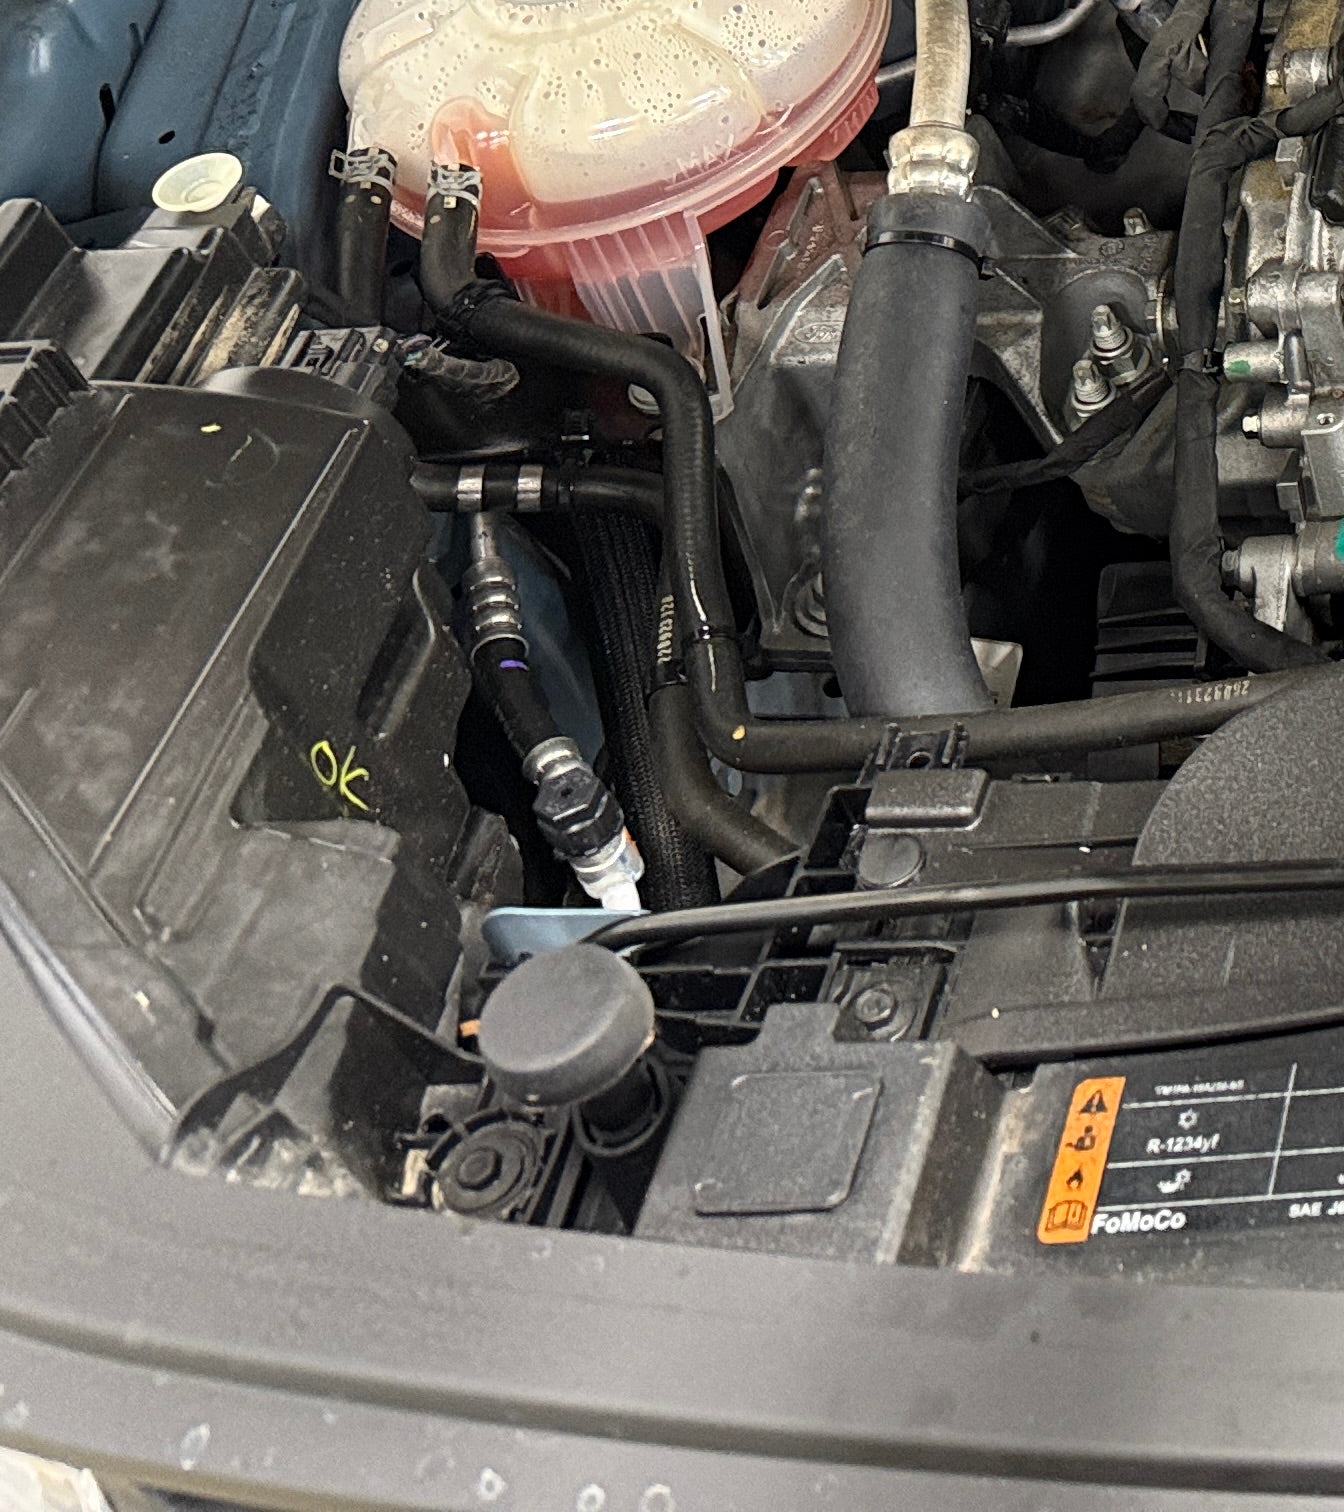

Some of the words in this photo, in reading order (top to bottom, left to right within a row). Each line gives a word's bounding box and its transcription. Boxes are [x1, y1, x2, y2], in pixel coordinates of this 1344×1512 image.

[310, 740, 370, 812] OK
[1145, 1133, 1221, 1154] R-1234yf
[1090, 1209, 1187, 1235] FoMoCo
